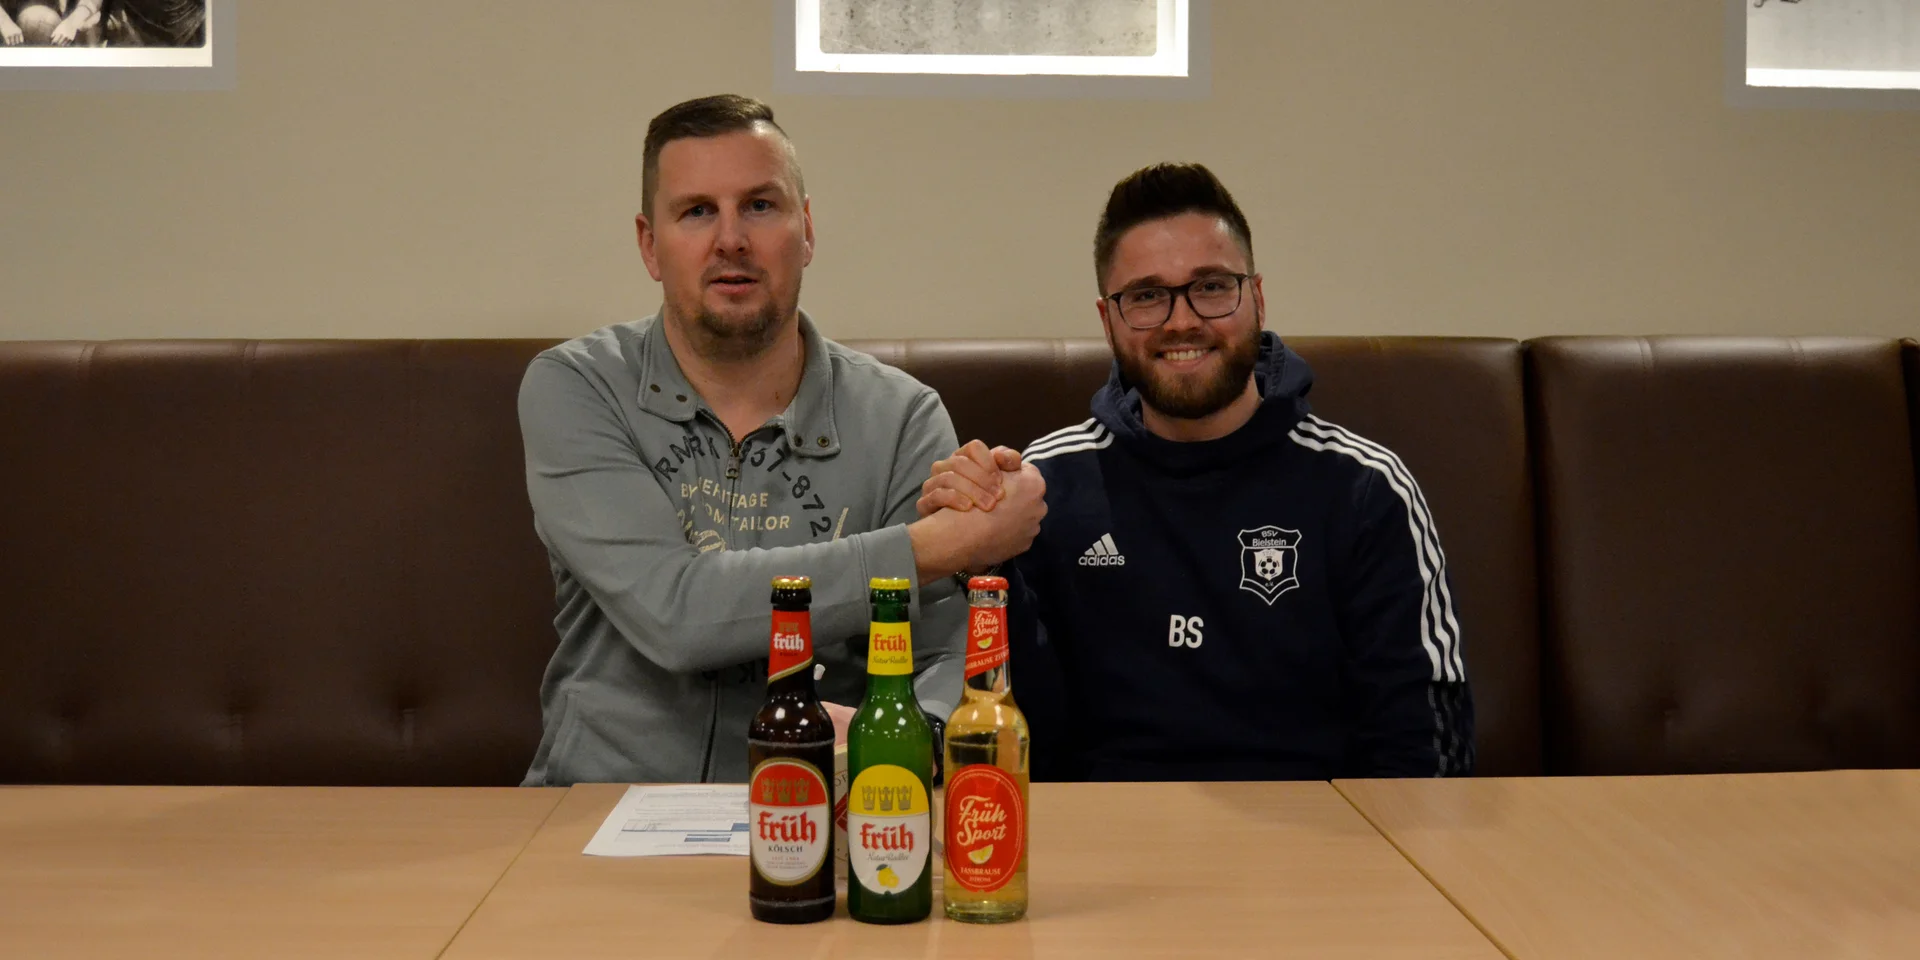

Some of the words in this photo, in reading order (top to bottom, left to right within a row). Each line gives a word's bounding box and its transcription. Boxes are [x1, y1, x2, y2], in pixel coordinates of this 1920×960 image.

[681, 482, 698, 499] BY
[1252, 537, 1287, 547] Bielstein
[1261, 529, 1279, 538] BSV
[1078, 555, 1126, 566] adidas
[973, 610, 999, 627] Früh
[1168, 614, 1205, 649] BS
[773, 632, 805, 652] früh
[873, 632, 907, 652] früh
[958, 795, 1008, 828] Früh
[757, 810, 817, 845] früh
[859, 822, 914, 853] früh
[956, 818, 1008, 847] Sport
[768, 844, 803, 853] KÖLSCH
